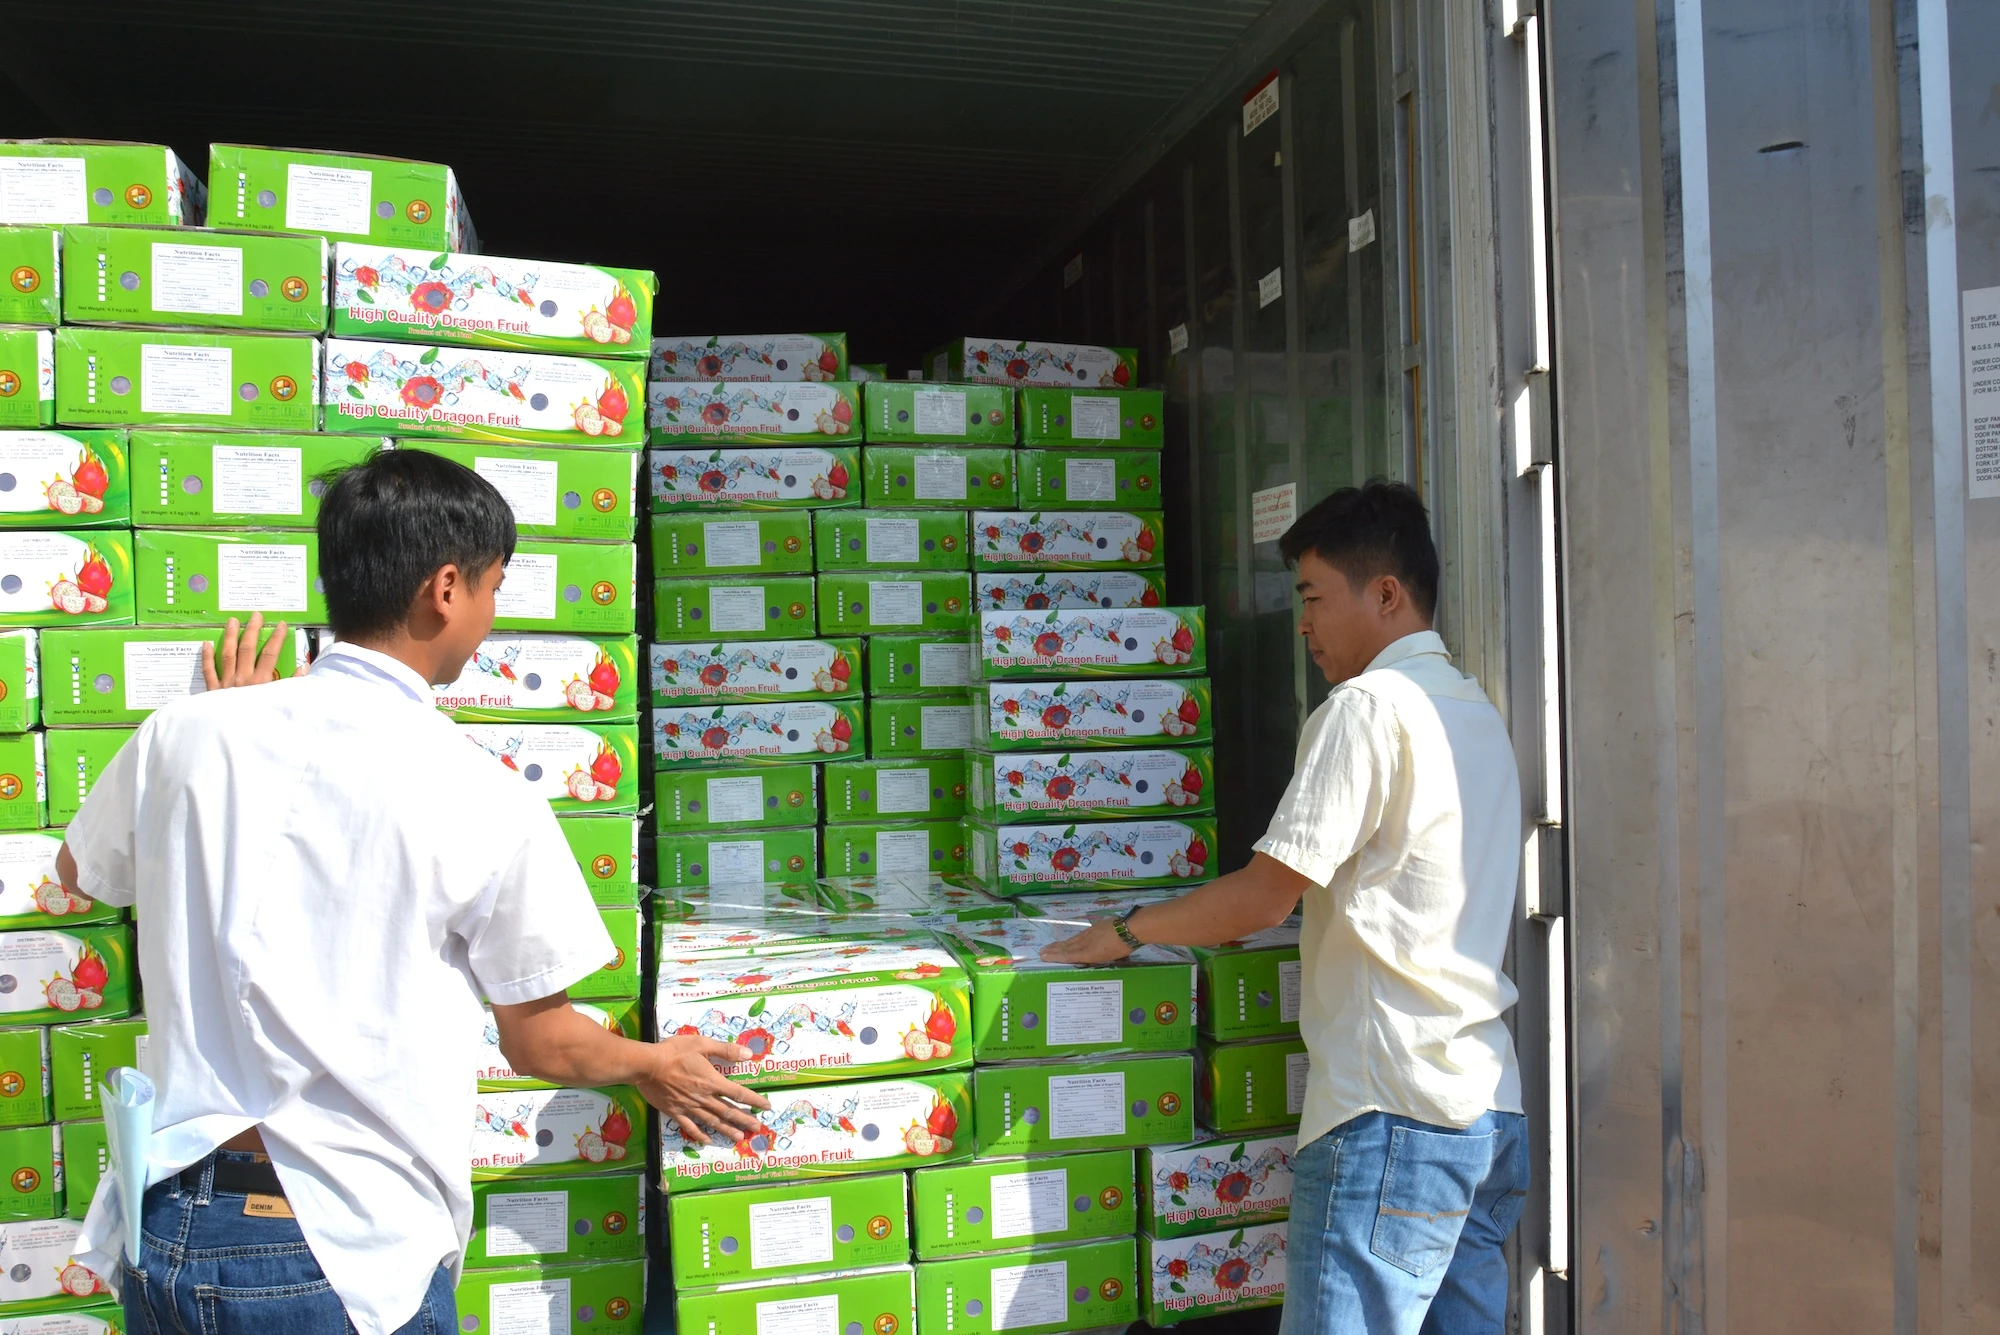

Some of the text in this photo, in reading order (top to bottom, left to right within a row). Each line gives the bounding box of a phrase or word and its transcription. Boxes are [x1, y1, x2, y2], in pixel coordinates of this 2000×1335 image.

[350, 306, 529, 332] High Quality Dragon Fruit
[751, 374, 771, 382] Fruit
[340, 402, 520, 426] High Quality Dragon Fruit
[663, 424, 781, 435] High Quality Dragon Fruit
[1975, 445, 1997, 453] BOTTOM
[1976, 452, 1998, 460] CORNER
[660, 490, 779, 503] High Quality Dragon Fruit
[984, 551, 1091, 563] High Quality Dragon Fruit
[992, 654, 1118, 667] High Quality Dragon Fruit
[661, 684, 779, 697] High Quality Dragon Fruit
[435, 694, 512, 708] ragon Fruit
[1000, 726, 1125, 740] High Quality Dragon Fruit
[662, 745, 781, 761] High Quality Dragon Fruit
[1005, 796, 1129, 812] High Quality Dragon Fruit
[1010, 868, 1134, 884] High Quality Dragon Fruit
[776, 980, 837, 989] Dragon
[840, 975, 880, 984] Fruit
[765, 1058, 815, 1072] Dragon
[820, 1052, 852, 1066] Fruit
[493, 1153, 525, 1165] Fruit
[676, 1148, 853, 1177] High Quality Dragon Fruit
[1165, 1196, 1286, 1224] High Quality Dragon
[1165, 1282, 1285, 1311] High Quality Dragon
